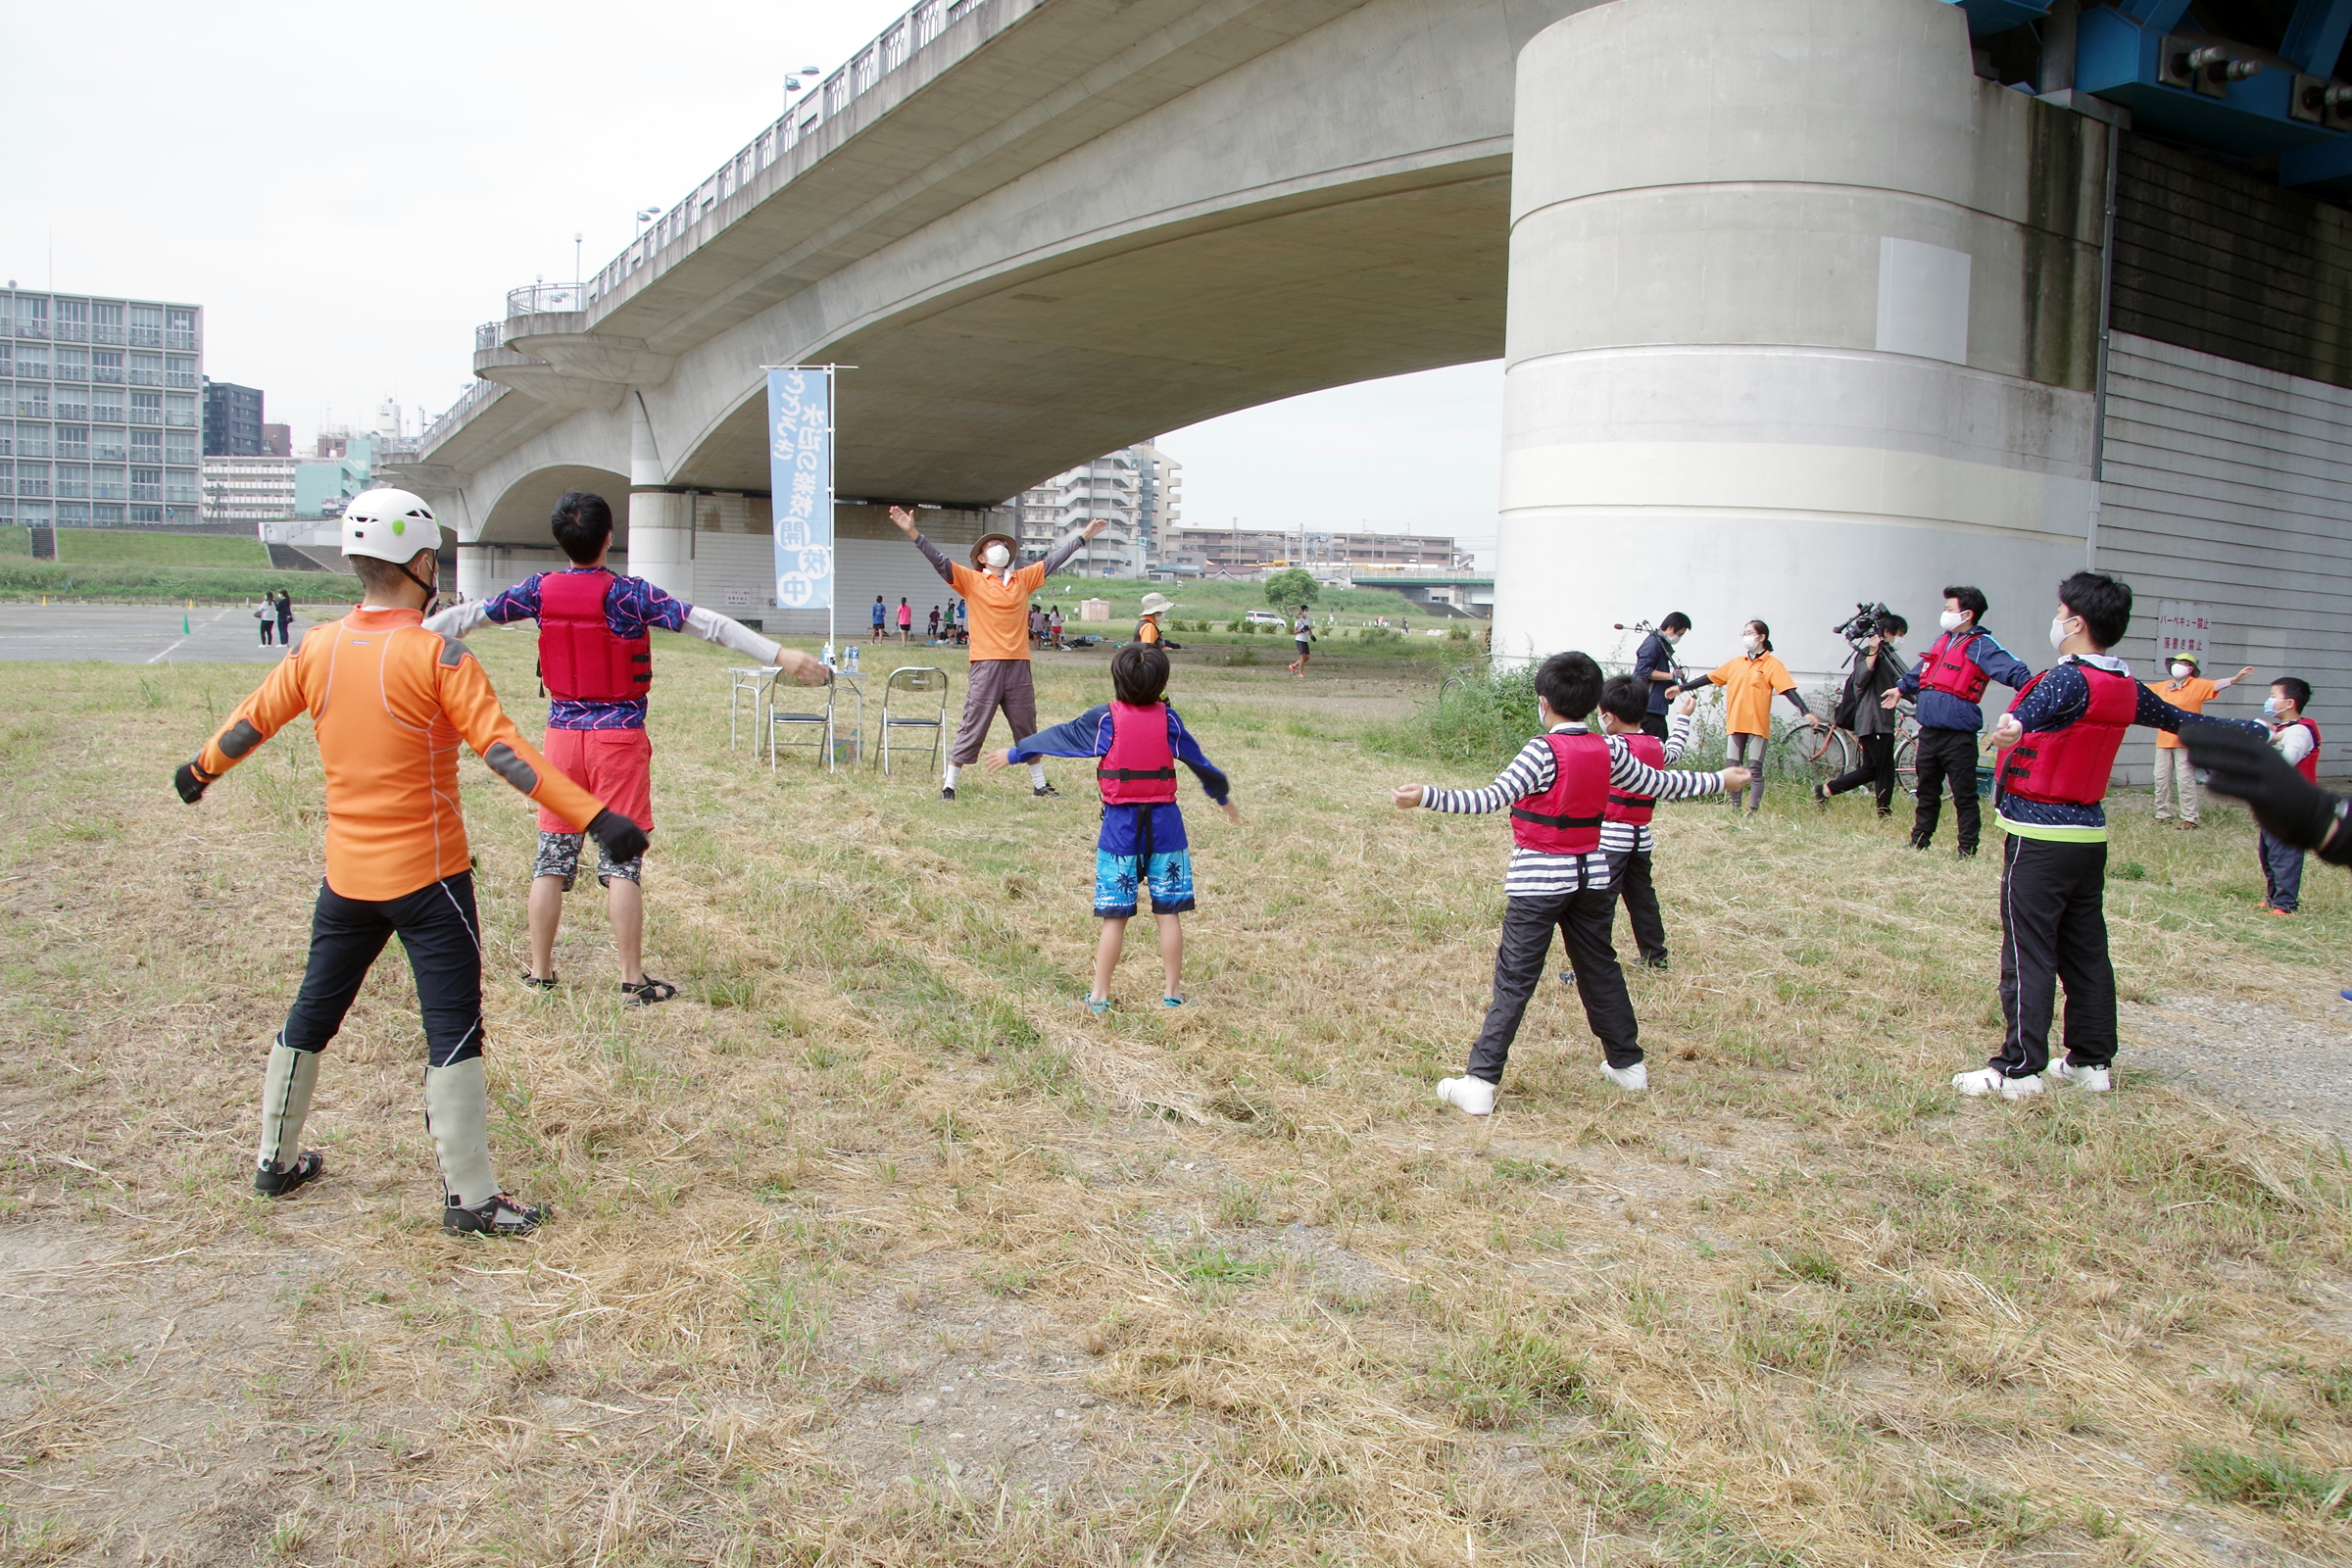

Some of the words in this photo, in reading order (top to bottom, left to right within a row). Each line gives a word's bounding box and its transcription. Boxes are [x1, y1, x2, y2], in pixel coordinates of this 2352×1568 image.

[2160, 615, 2209, 629] バーベキュー禁止
[2164, 637, 2202, 651] 落書き禁止
